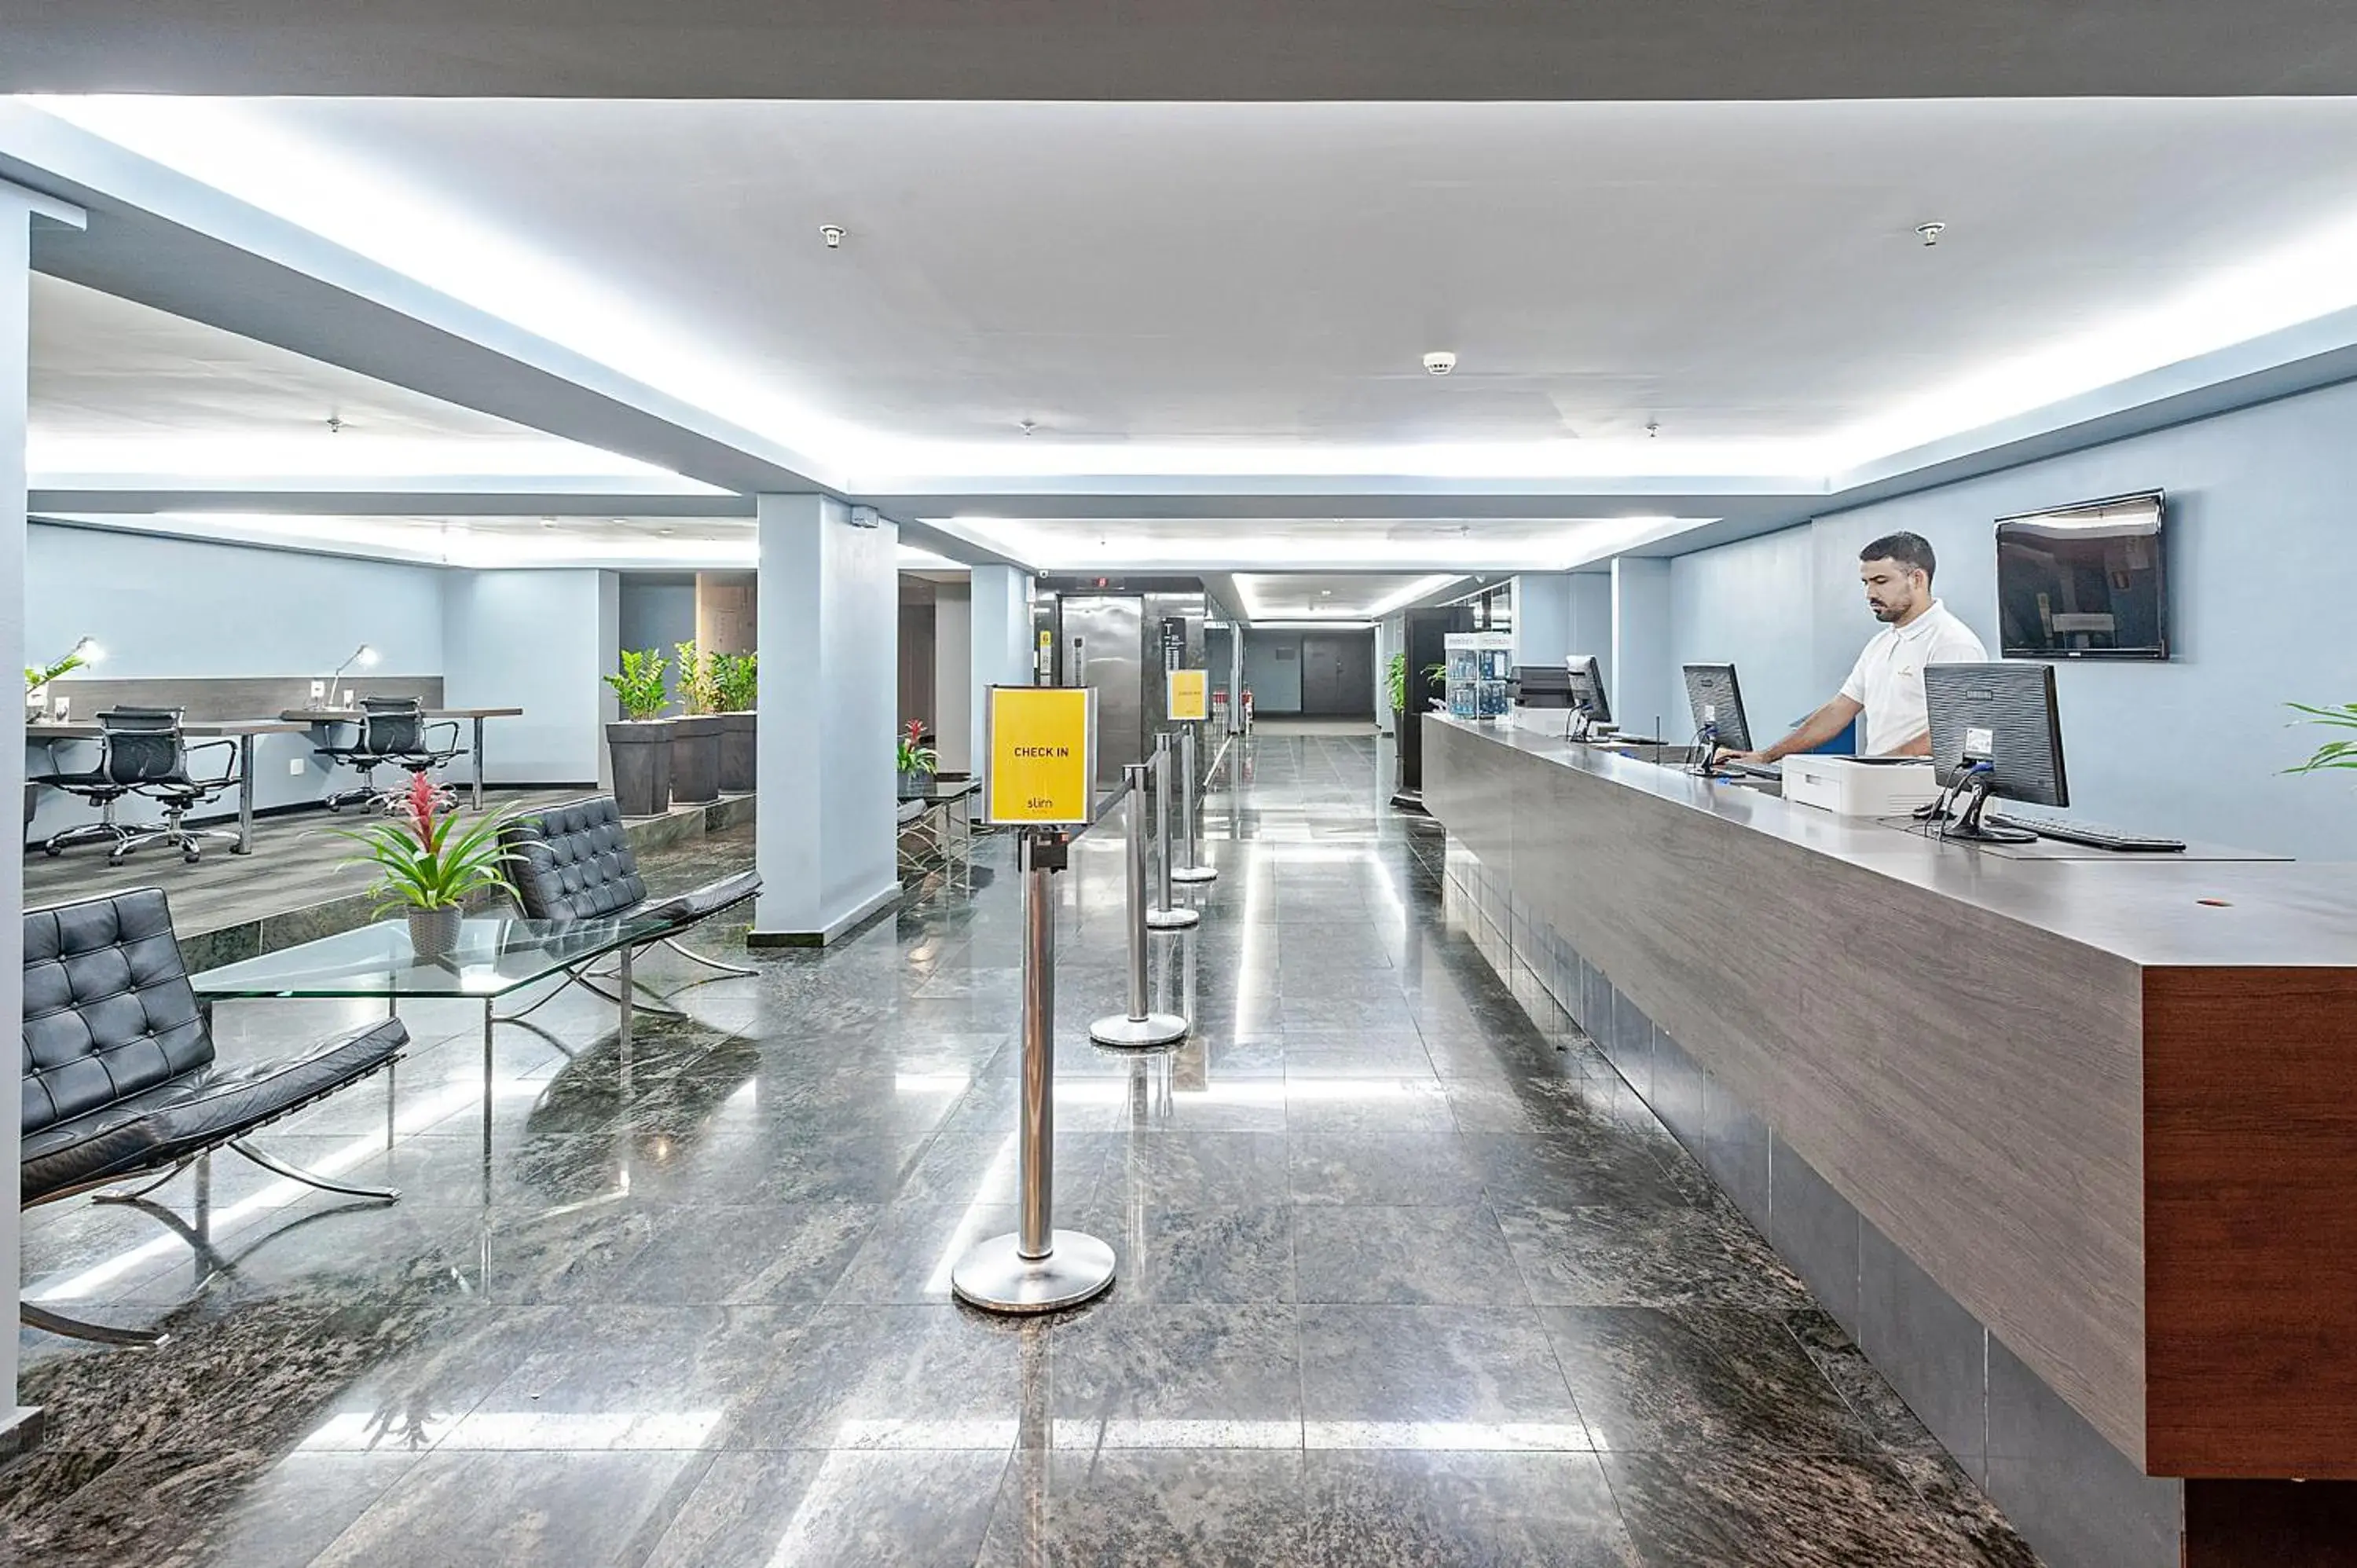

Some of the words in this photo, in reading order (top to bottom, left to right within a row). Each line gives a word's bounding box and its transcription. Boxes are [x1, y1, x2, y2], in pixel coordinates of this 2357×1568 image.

[1014, 747, 1054, 757] CHECK
[1057, 747, 1069, 757] IN
[1028, 797, 1054, 808] slim
